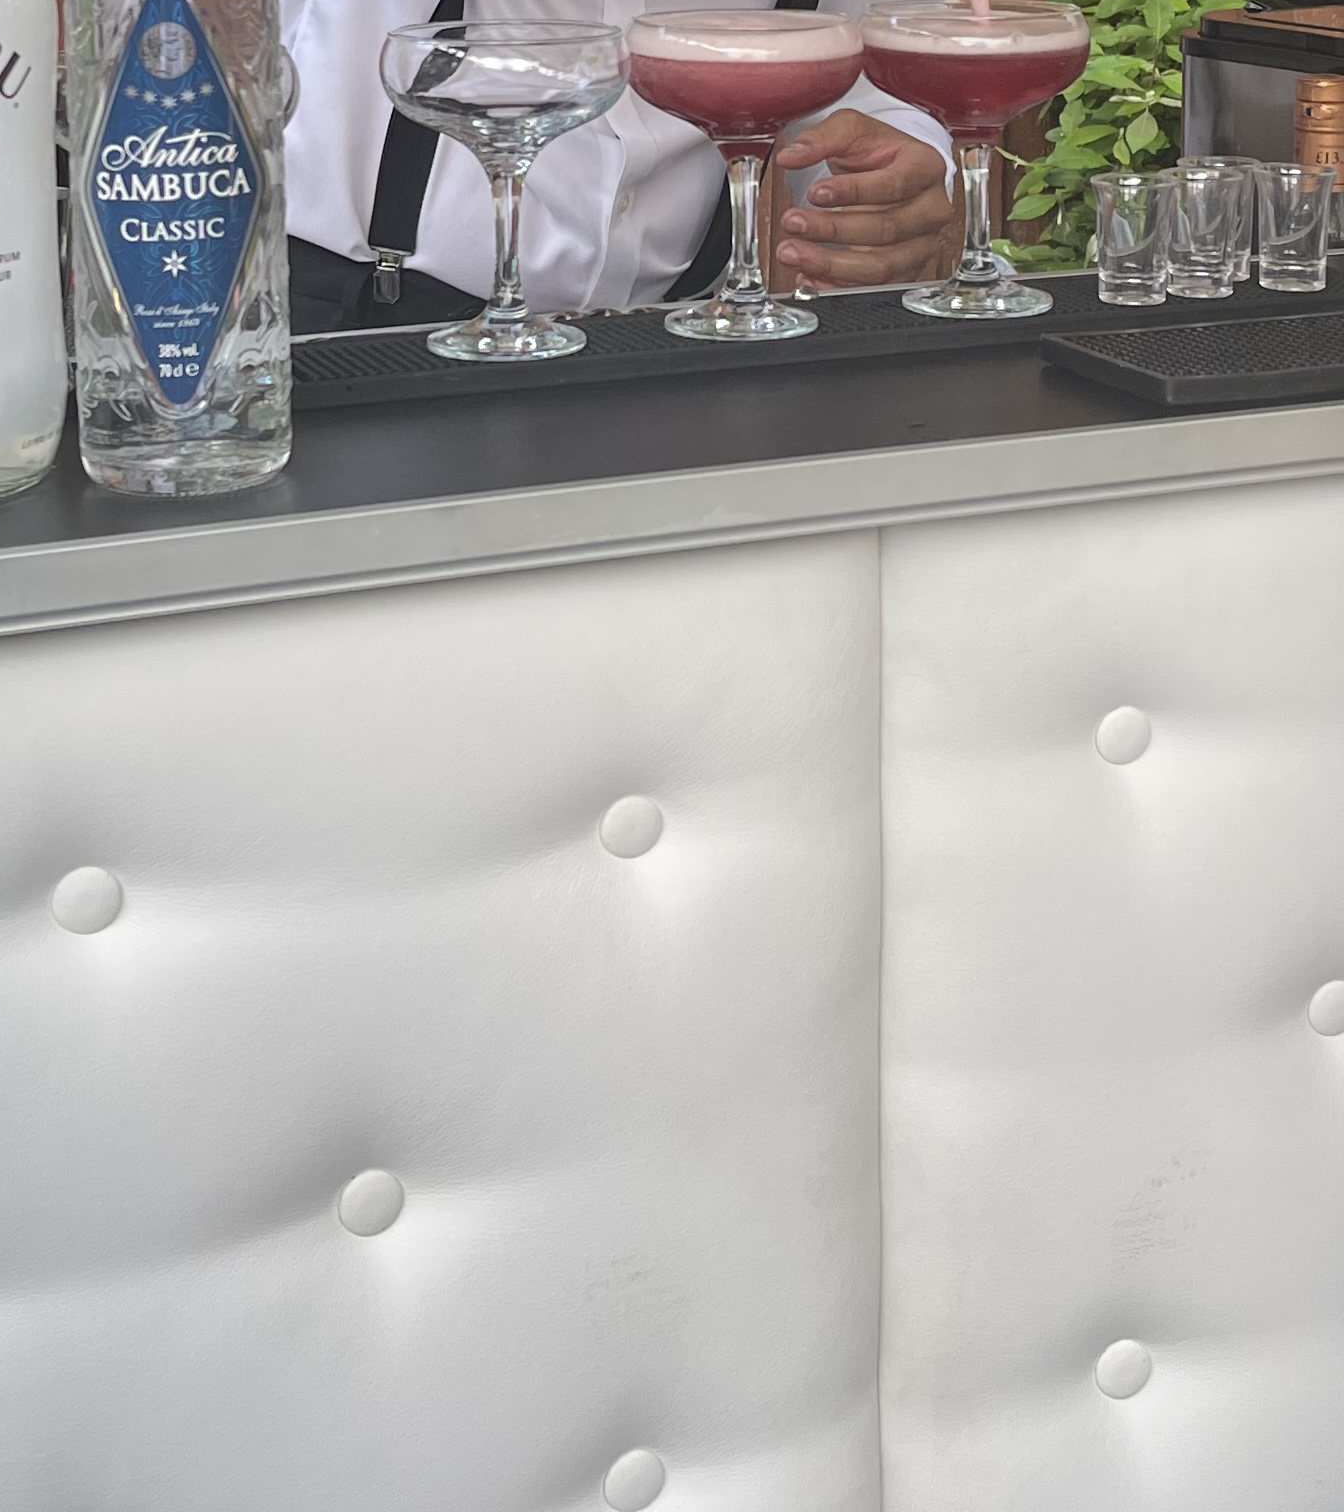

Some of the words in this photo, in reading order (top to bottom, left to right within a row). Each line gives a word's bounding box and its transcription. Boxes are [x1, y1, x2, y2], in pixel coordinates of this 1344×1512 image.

[101, 125, 239, 171] Antica
[96, 167, 251, 201] SAMBUCA
[120, 217, 225, 242] CLASSIC
